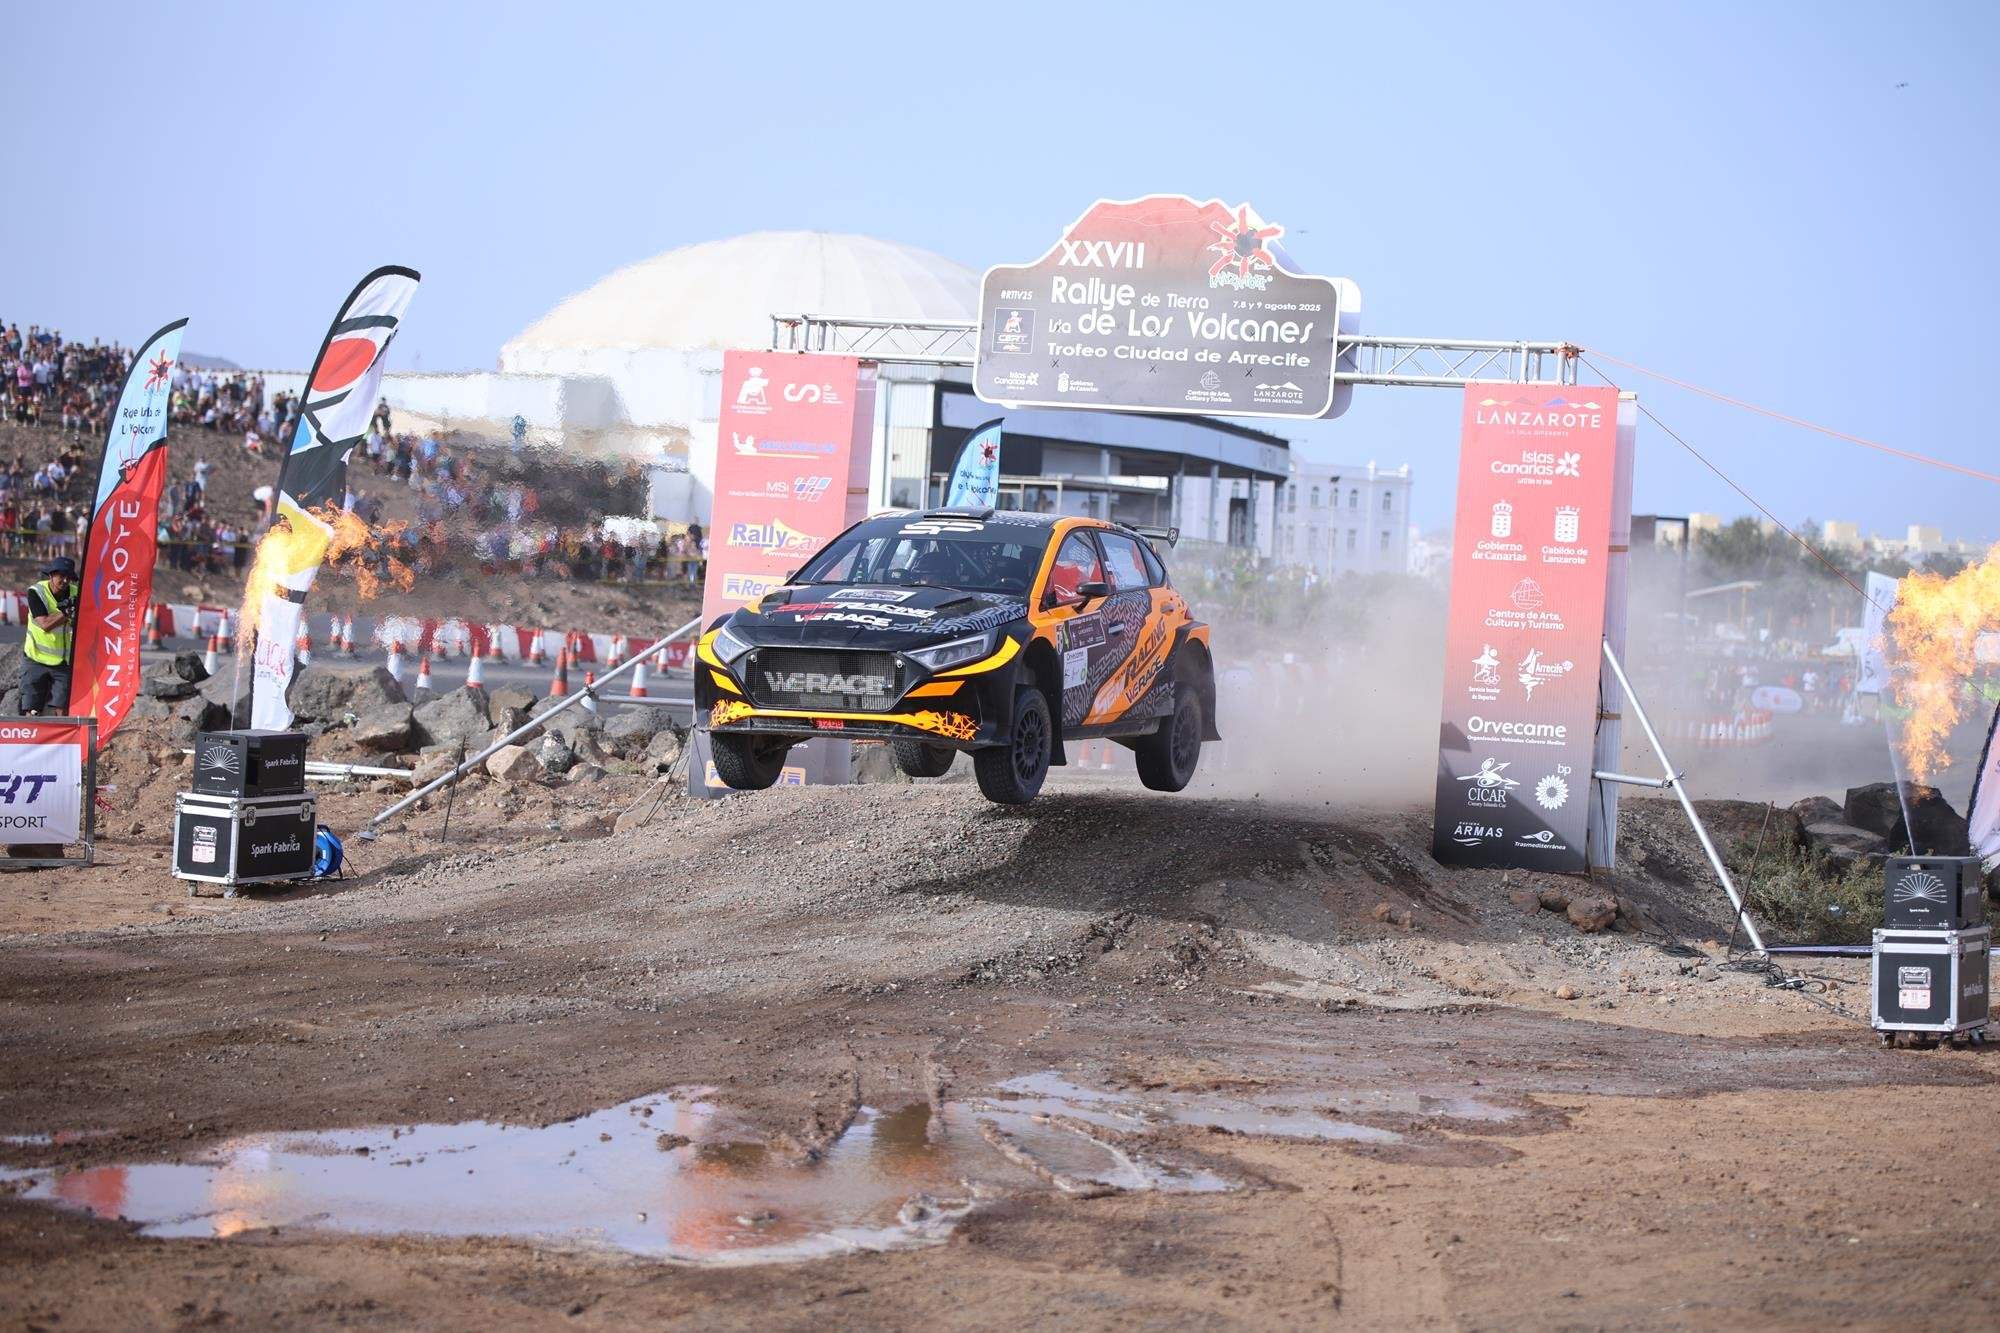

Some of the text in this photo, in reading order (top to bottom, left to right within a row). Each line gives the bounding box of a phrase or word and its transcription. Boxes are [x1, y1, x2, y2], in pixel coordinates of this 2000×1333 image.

[1058, 240, 1145, 269] XXVII
[1051, 276, 1209, 312] Rallye de Tierra
[1248, 301, 1255, 311] y
[1256, 301, 1262, 309] 9
[1264, 302, 1297, 312] agosto
[1299, 303, 1321, 312] 2025
[1078, 308, 1116, 336] de
[1128, 309, 1174, 338] Los
[1187, 312, 1314, 344] Volcanes
[1047, 342, 1311, 367] Trofeo Ciudad de Arrecife
[1253, 391, 1303, 399] LANZAROTE
[1476, 410, 1601, 428] LANZAROTE
[1522, 451, 1554, 464] Islas
[1491, 461, 1554, 476] Canarias
[1477, 541, 1523, 551] Gobierno
[1542, 546, 1588, 556] Cabildo de
[1472, 551, 1527, 562] de Canarias
[1543, 555, 1586, 565] Lanzarote
[103, 500, 140, 717] ANZAROTE
[1488, 608, 1561, 622] Centros de Arte,
[1485, 618, 1565, 631] Cultura y Turismo
[1534, 663, 1563, 675] Arrecife
[764, 671, 885, 696] WERACE
[1125, 655, 1165, 704] WERACE
[0, 727, 38, 739] anes
[1467, 716, 1567, 738] Orvecame
[264, 757, 299, 769] Spark Fabrica
[1557, 763, 1572, 776] bp
[1468, 787, 1507, 803] CICAR
[1454, 826, 1503, 838] ARMAS
[251, 841, 300, 858] Spark Fabrica
[1514, 841, 1566, 850] Trasmediterránea
